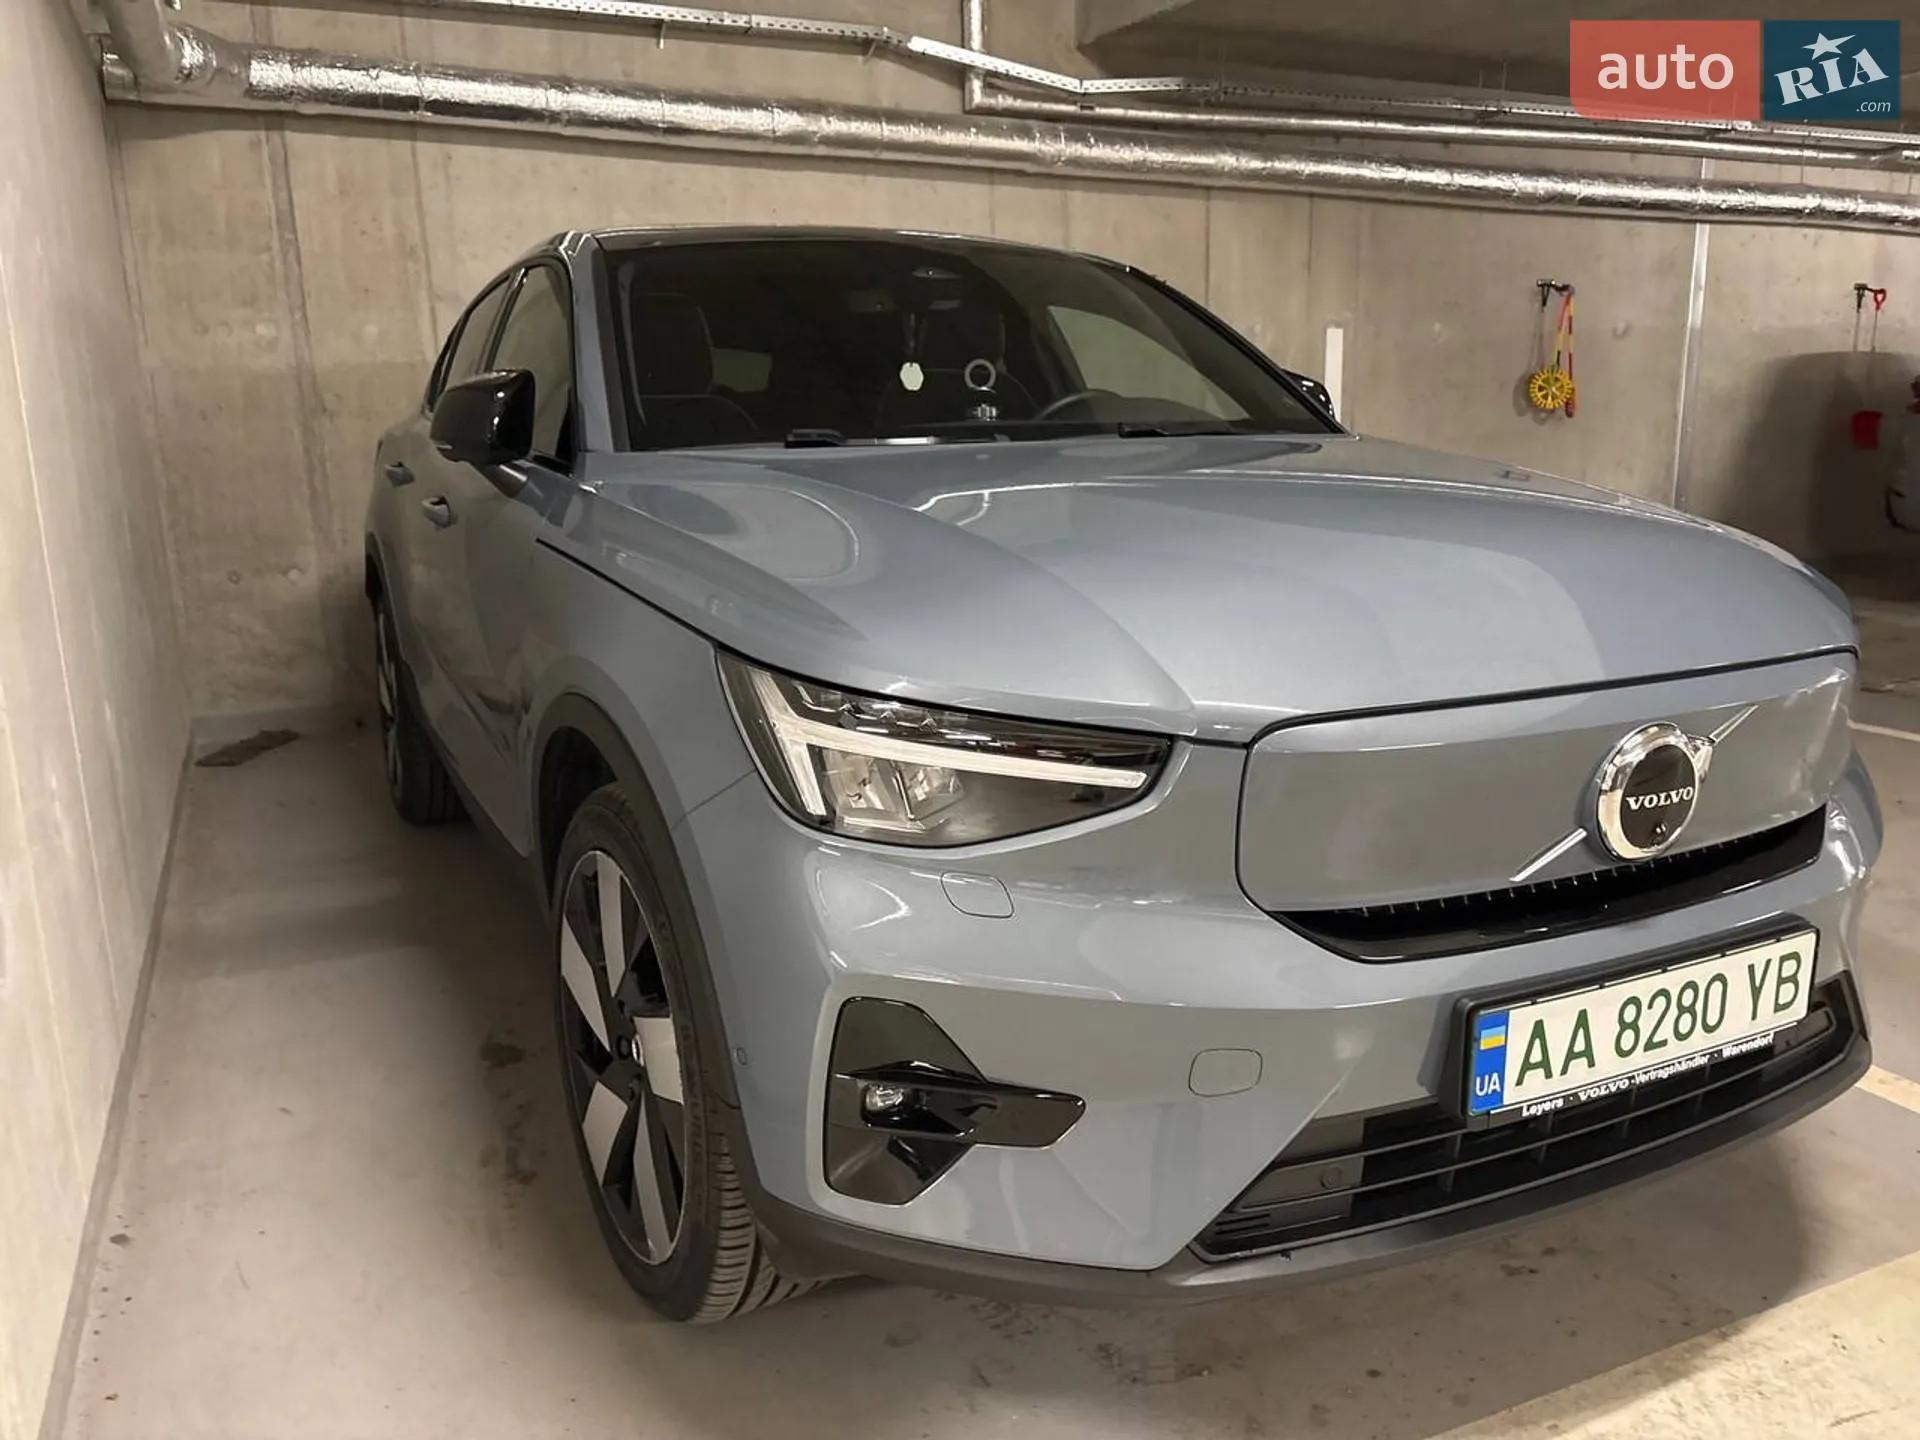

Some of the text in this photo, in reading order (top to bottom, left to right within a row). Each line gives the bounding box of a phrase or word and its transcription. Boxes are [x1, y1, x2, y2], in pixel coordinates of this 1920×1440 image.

[1626, 786, 1694, 811] VOLVO
[1515, 951, 1803, 1088] AA 8280 YB
[1475, 1072, 1501, 1097] UA
[1577, 1078, 1630, 1102] VOLVO
